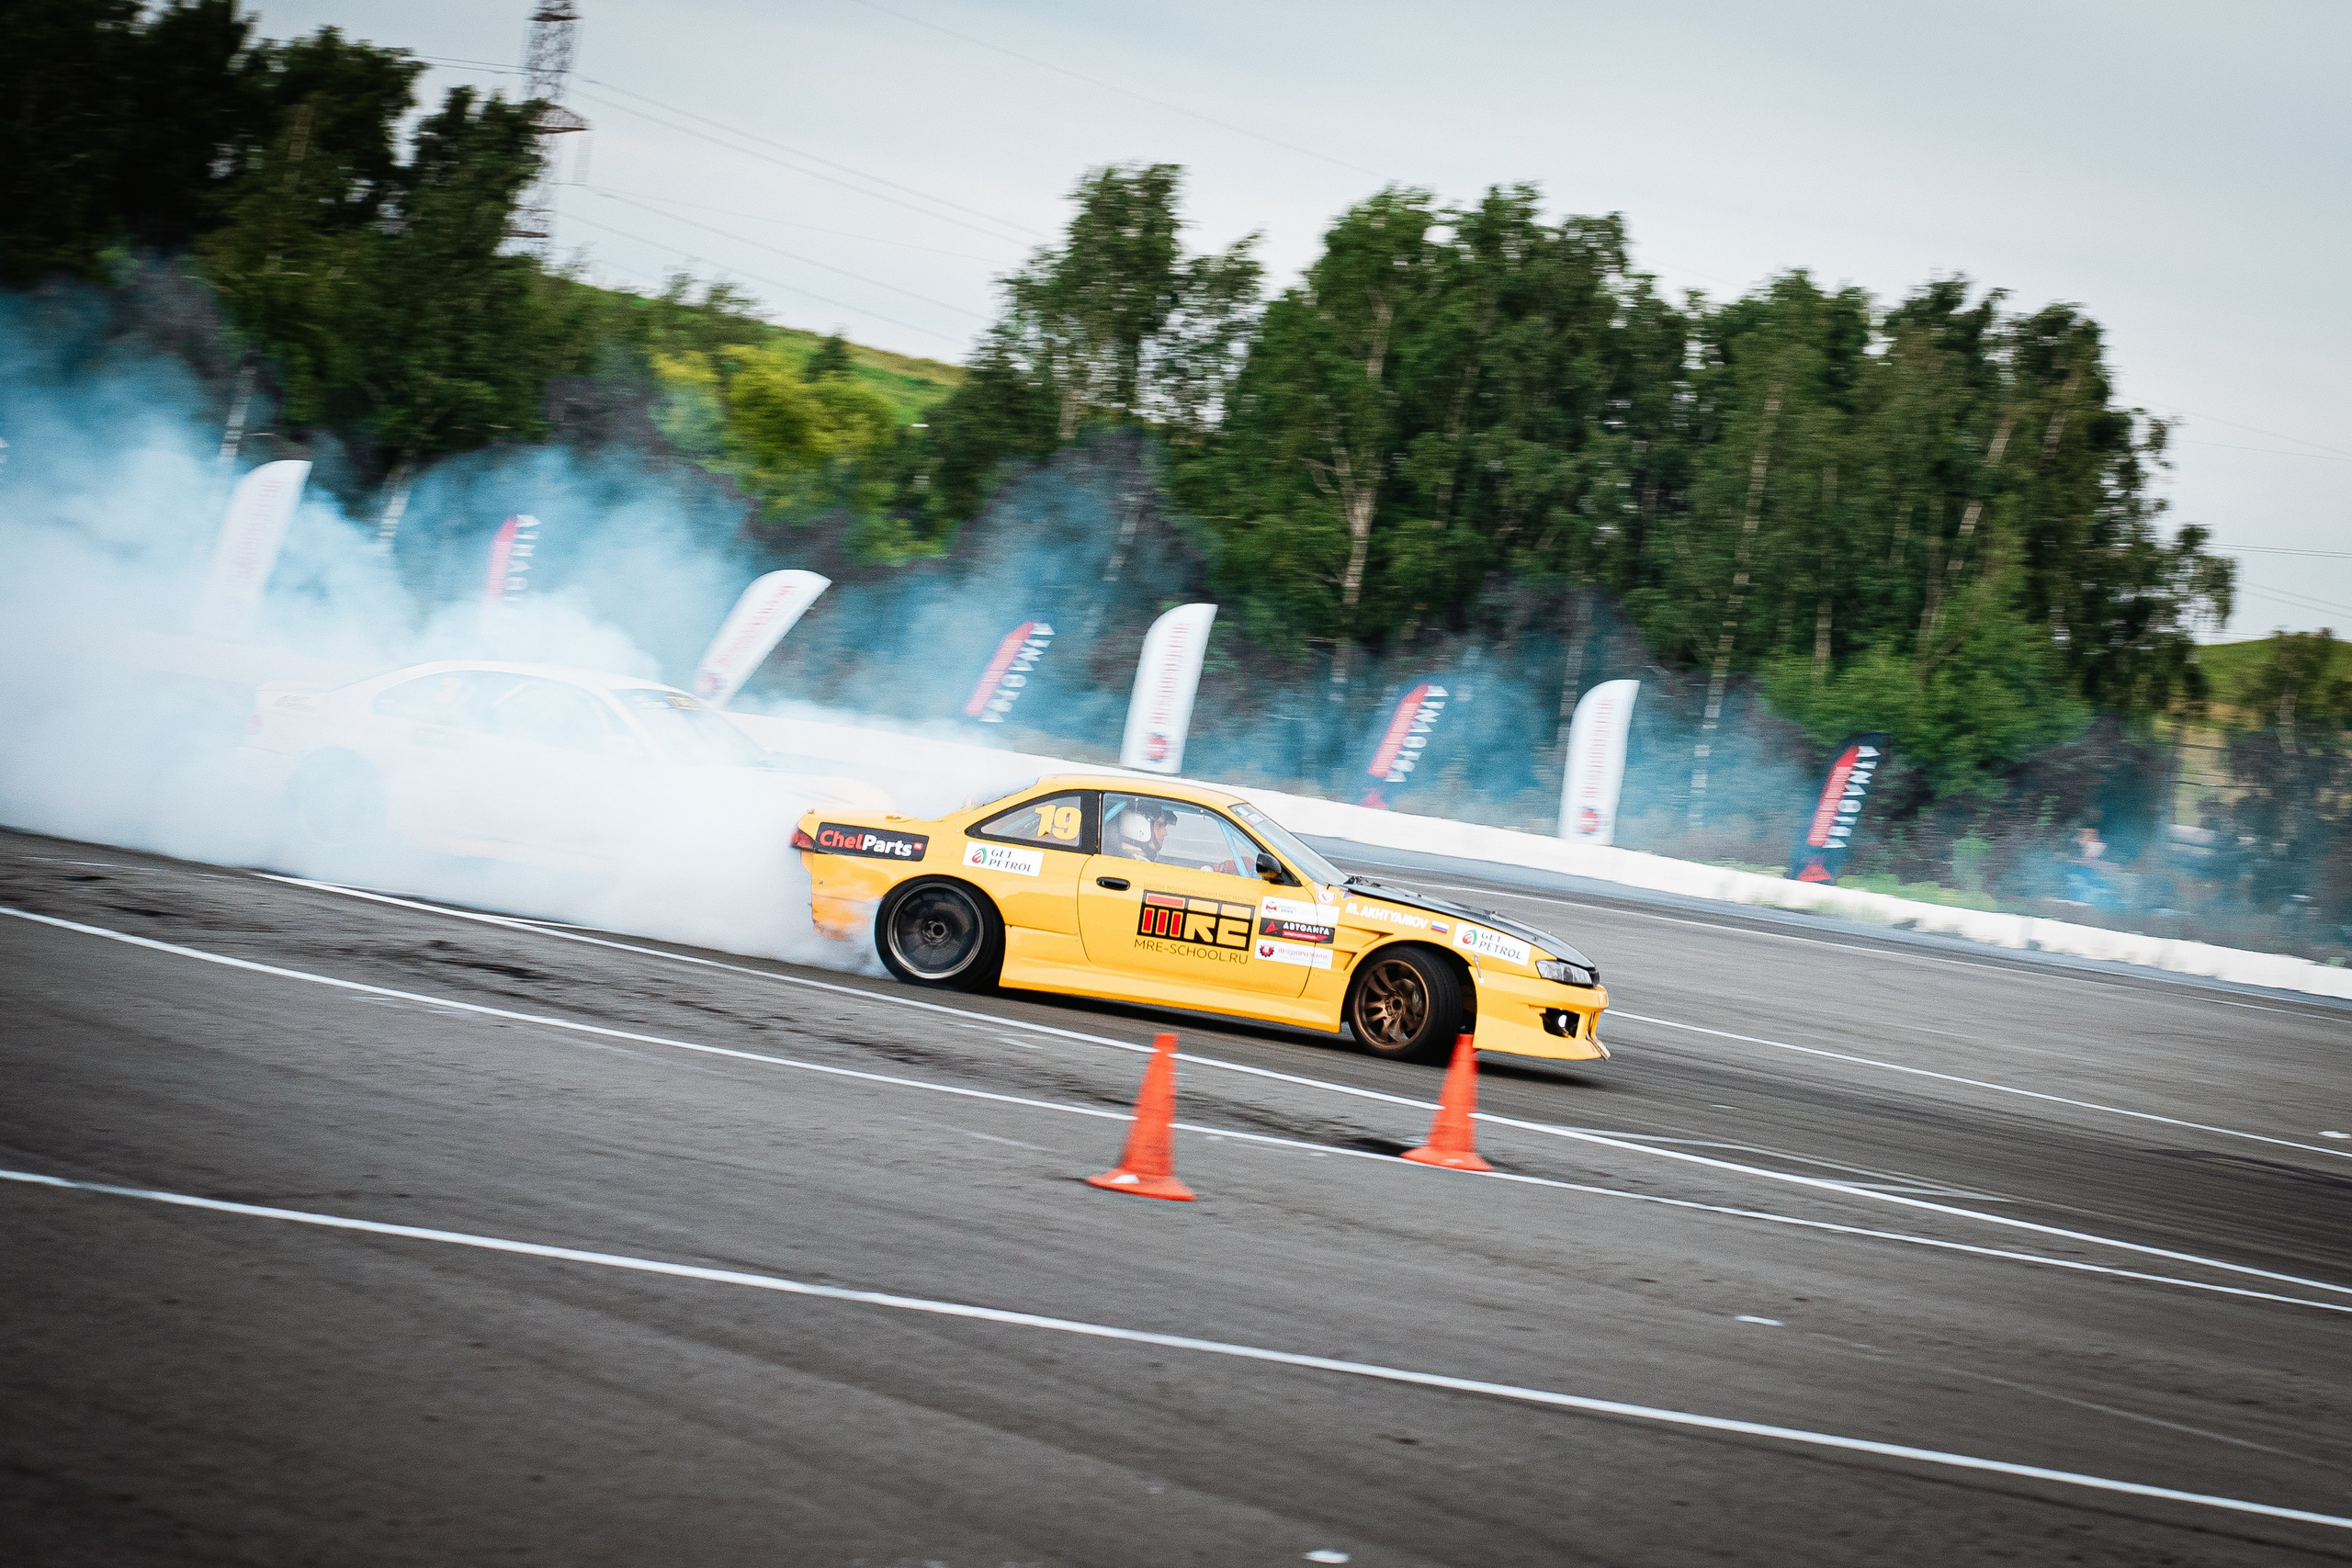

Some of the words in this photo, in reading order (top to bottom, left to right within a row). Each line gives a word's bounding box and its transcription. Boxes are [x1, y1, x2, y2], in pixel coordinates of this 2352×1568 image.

[1035, 804, 1082, 840] 19
[819, 829, 913, 857] ChelParts
[990, 848, 1014, 859] GET
[989, 858, 1033, 873] PETROL
[1345, 901, 1360, 915] M.
[1361, 905, 1430, 930] AKHTYAMOV
[1283, 921, 1330, 936] АВТОЛИГА
[1481, 931, 1501, 942] GET
[1134, 939, 1249, 965] MRE-SCHOOL.RU
[1478, 941, 1521, 960] PETROL
